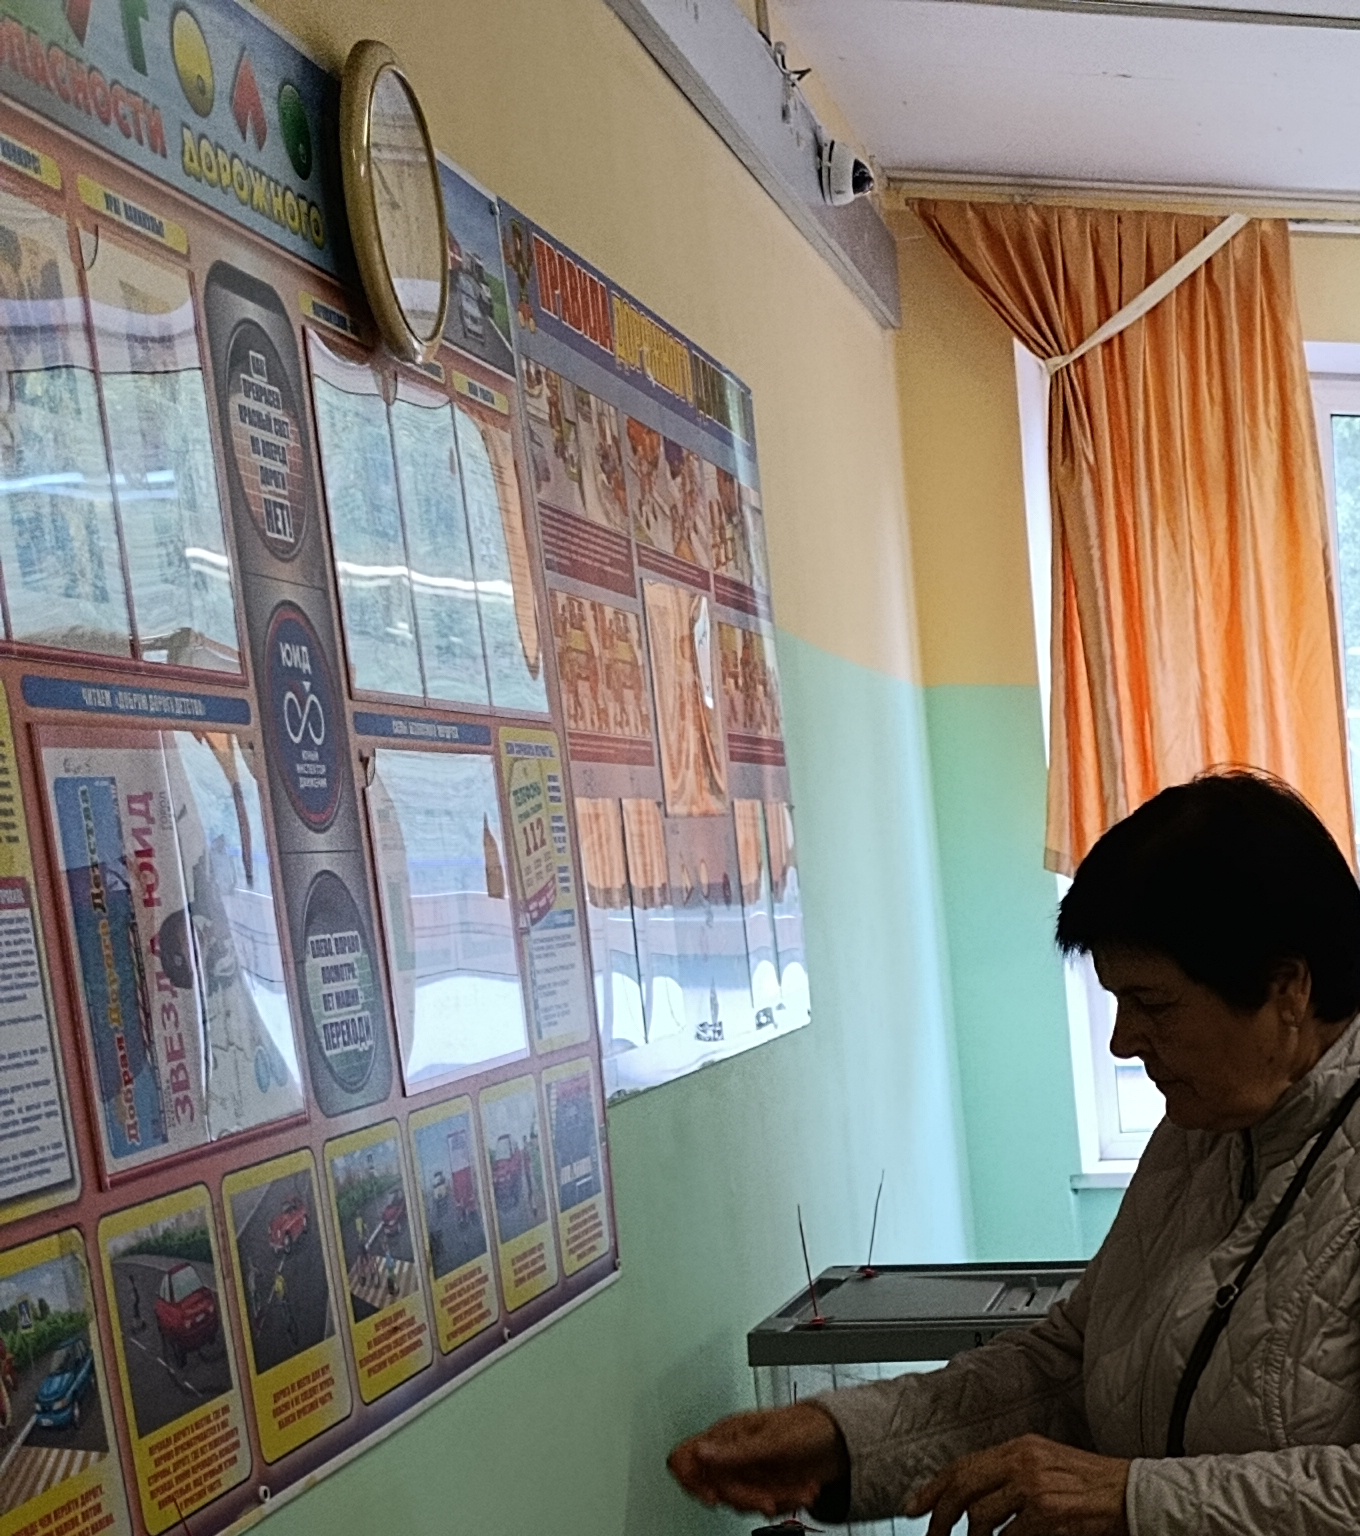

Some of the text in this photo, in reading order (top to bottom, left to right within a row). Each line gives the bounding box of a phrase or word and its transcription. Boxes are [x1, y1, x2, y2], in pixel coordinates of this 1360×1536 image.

[0, 15, 167, 159] ПАСНОСТИ
[182, 123, 325, 250] ДОРОЖНОГО
[533, 232, 614, 356] ПРАВИЛА
[264, 498, 293, 539] НЕТ!
[280, 642, 312, 675] ЮИД
[523, 817, 547, 857] 112
[127, 790, 195, 1126] ЗВЕЗД ЮИД
[323, 1014, 373, 1051] ПЕРЕХОДИ
